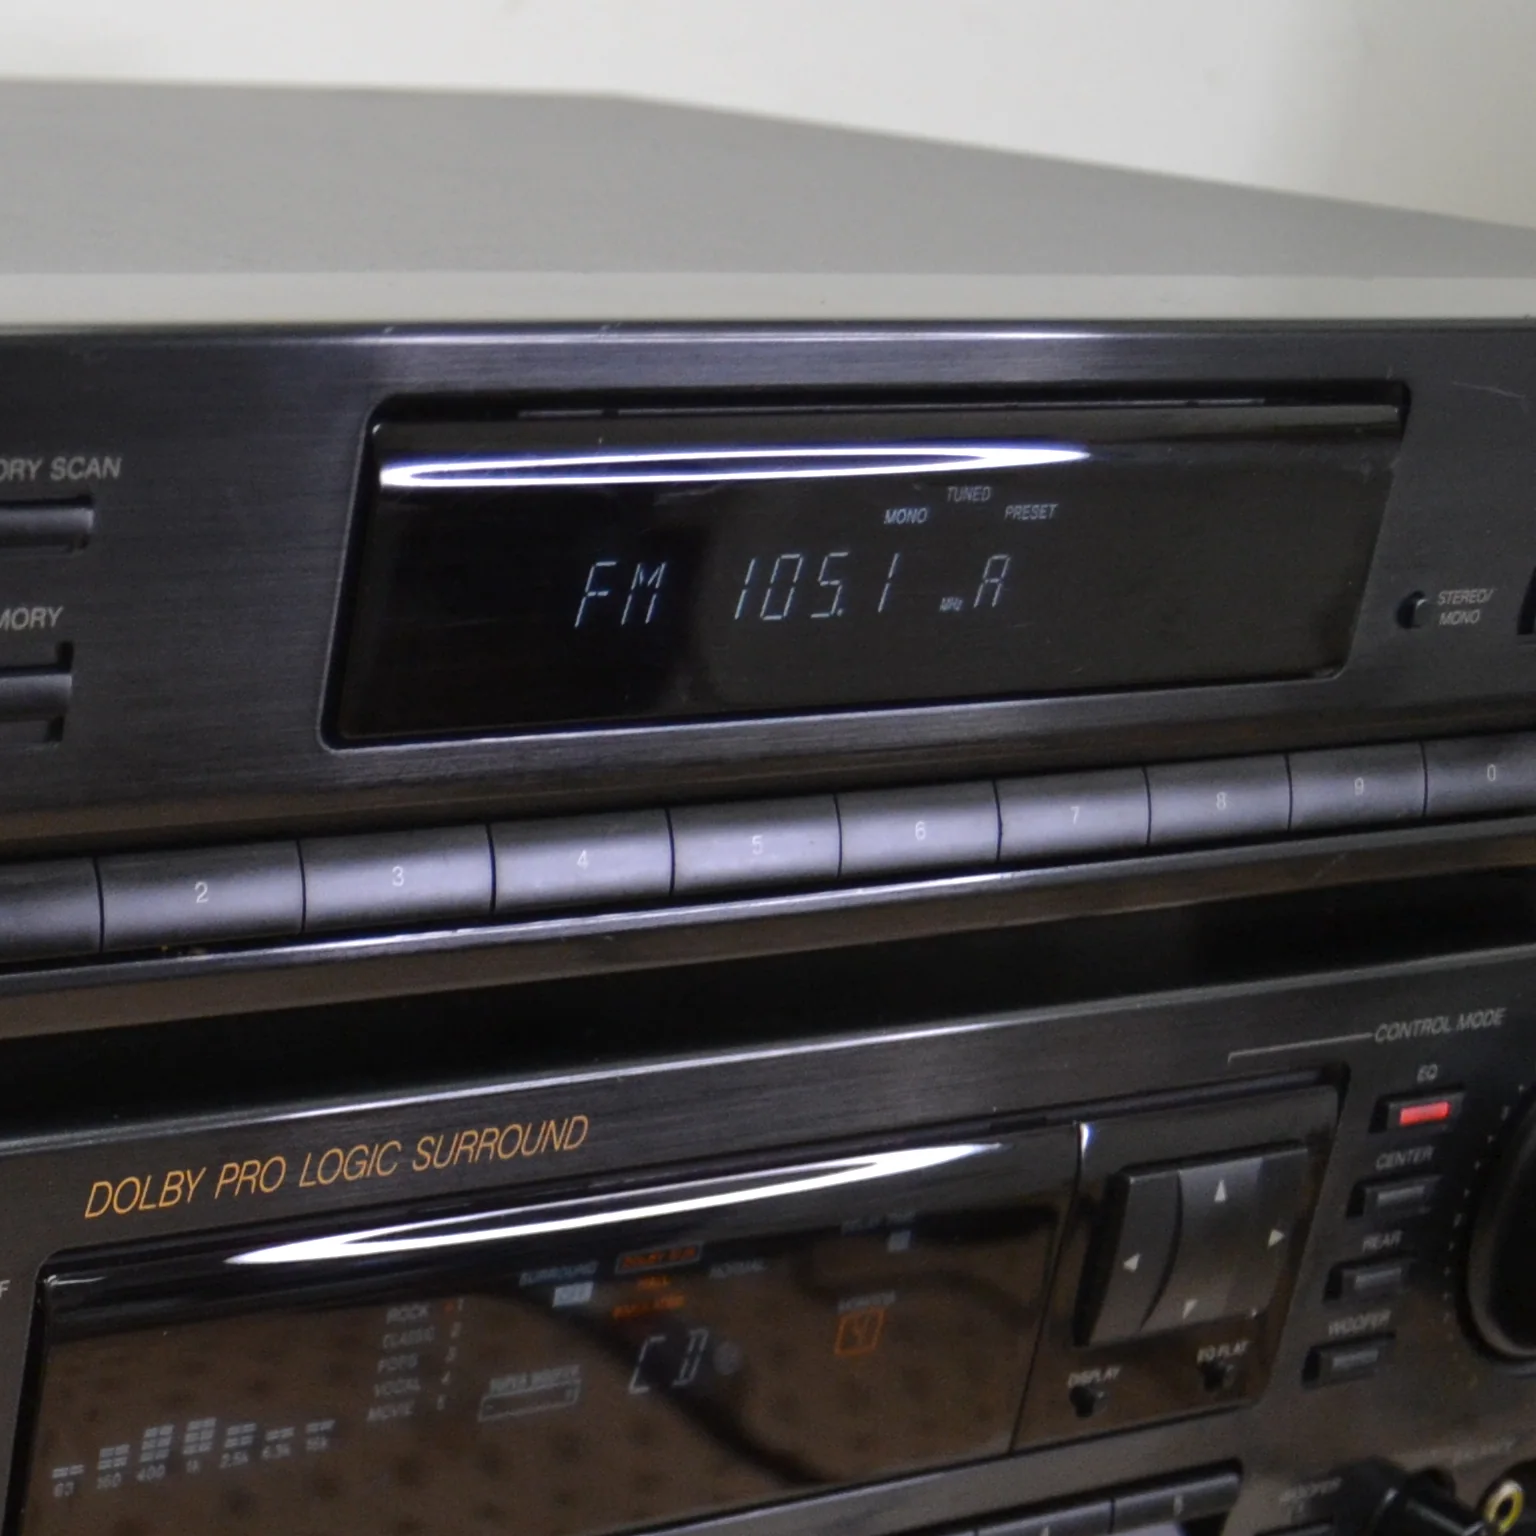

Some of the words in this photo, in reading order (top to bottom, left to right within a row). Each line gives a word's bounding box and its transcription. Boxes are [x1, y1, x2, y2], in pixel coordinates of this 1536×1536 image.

[50, 456, 123, 481] SCAN
[946, 486, 992, 503] TUNED
[884, 507, 928, 525] MONO
[1005, 503, 1058, 521] PRESET
[575, 560, 668, 628] FM
[973, 554, 1011, 609] A
[1439, 609, 1481, 626] MONO
[1353, 777, 1364, 796] 9
[1215, 792, 1227, 810] 8
[1070, 805, 1081, 824] 7
[914, 820, 926, 840] 6
[752, 835, 764, 855] 5
[576, 849, 589, 870] 4
[391, 866, 405, 888] 3
[194, 882, 209, 903] 2
[1374, 1016, 1451, 1043] CONTROL
[1456, 1007, 1508, 1032] MODE
[1416, 1063, 1440, 1083] EQ
[84, 1166, 207, 1219] DOLBY
[214, 1156, 286, 1199] PRO
[299, 1140, 402, 1189] LOGIC
[412, 1114, 590, 1172] SURROUND
[1375, 1145, 1436, 1172] CENTER
